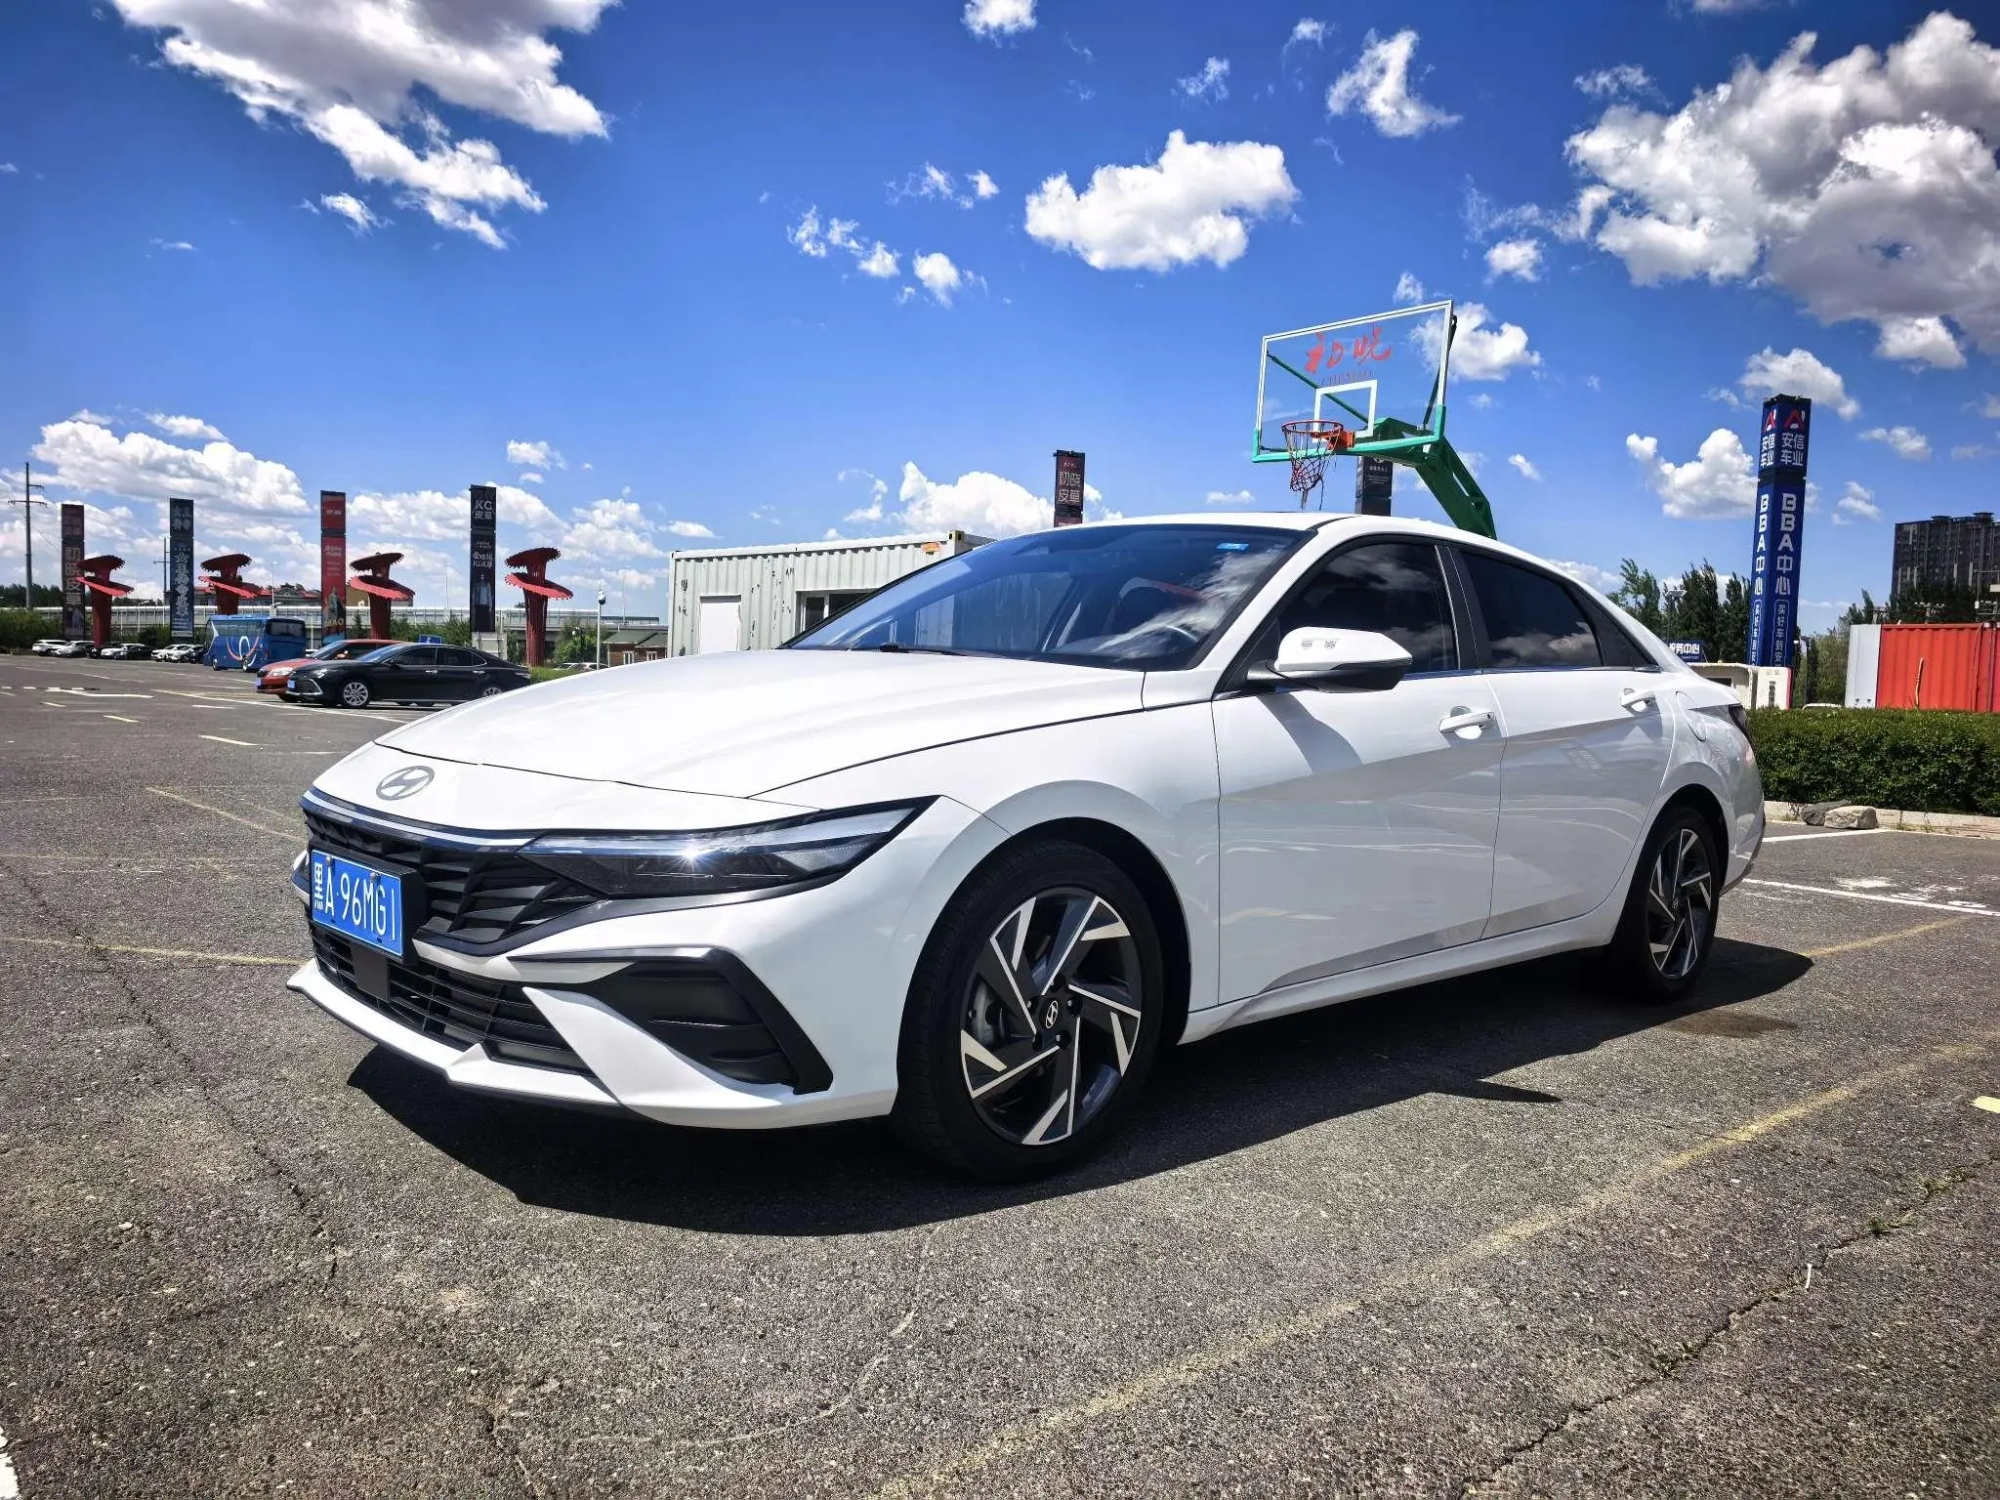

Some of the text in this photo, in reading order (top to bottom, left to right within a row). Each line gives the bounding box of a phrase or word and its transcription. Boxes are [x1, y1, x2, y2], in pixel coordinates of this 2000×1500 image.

[1780, 450, 1804, 466] 车业
[1781, 433, 1805, 450] 安信
[475, 500, 493, 511] KC
[1754, 493, 1769, 596] BBA中心
[1775, 492, 1798, 596] BBA中心
[1773, 603, 1787, 667] 买好车到安
